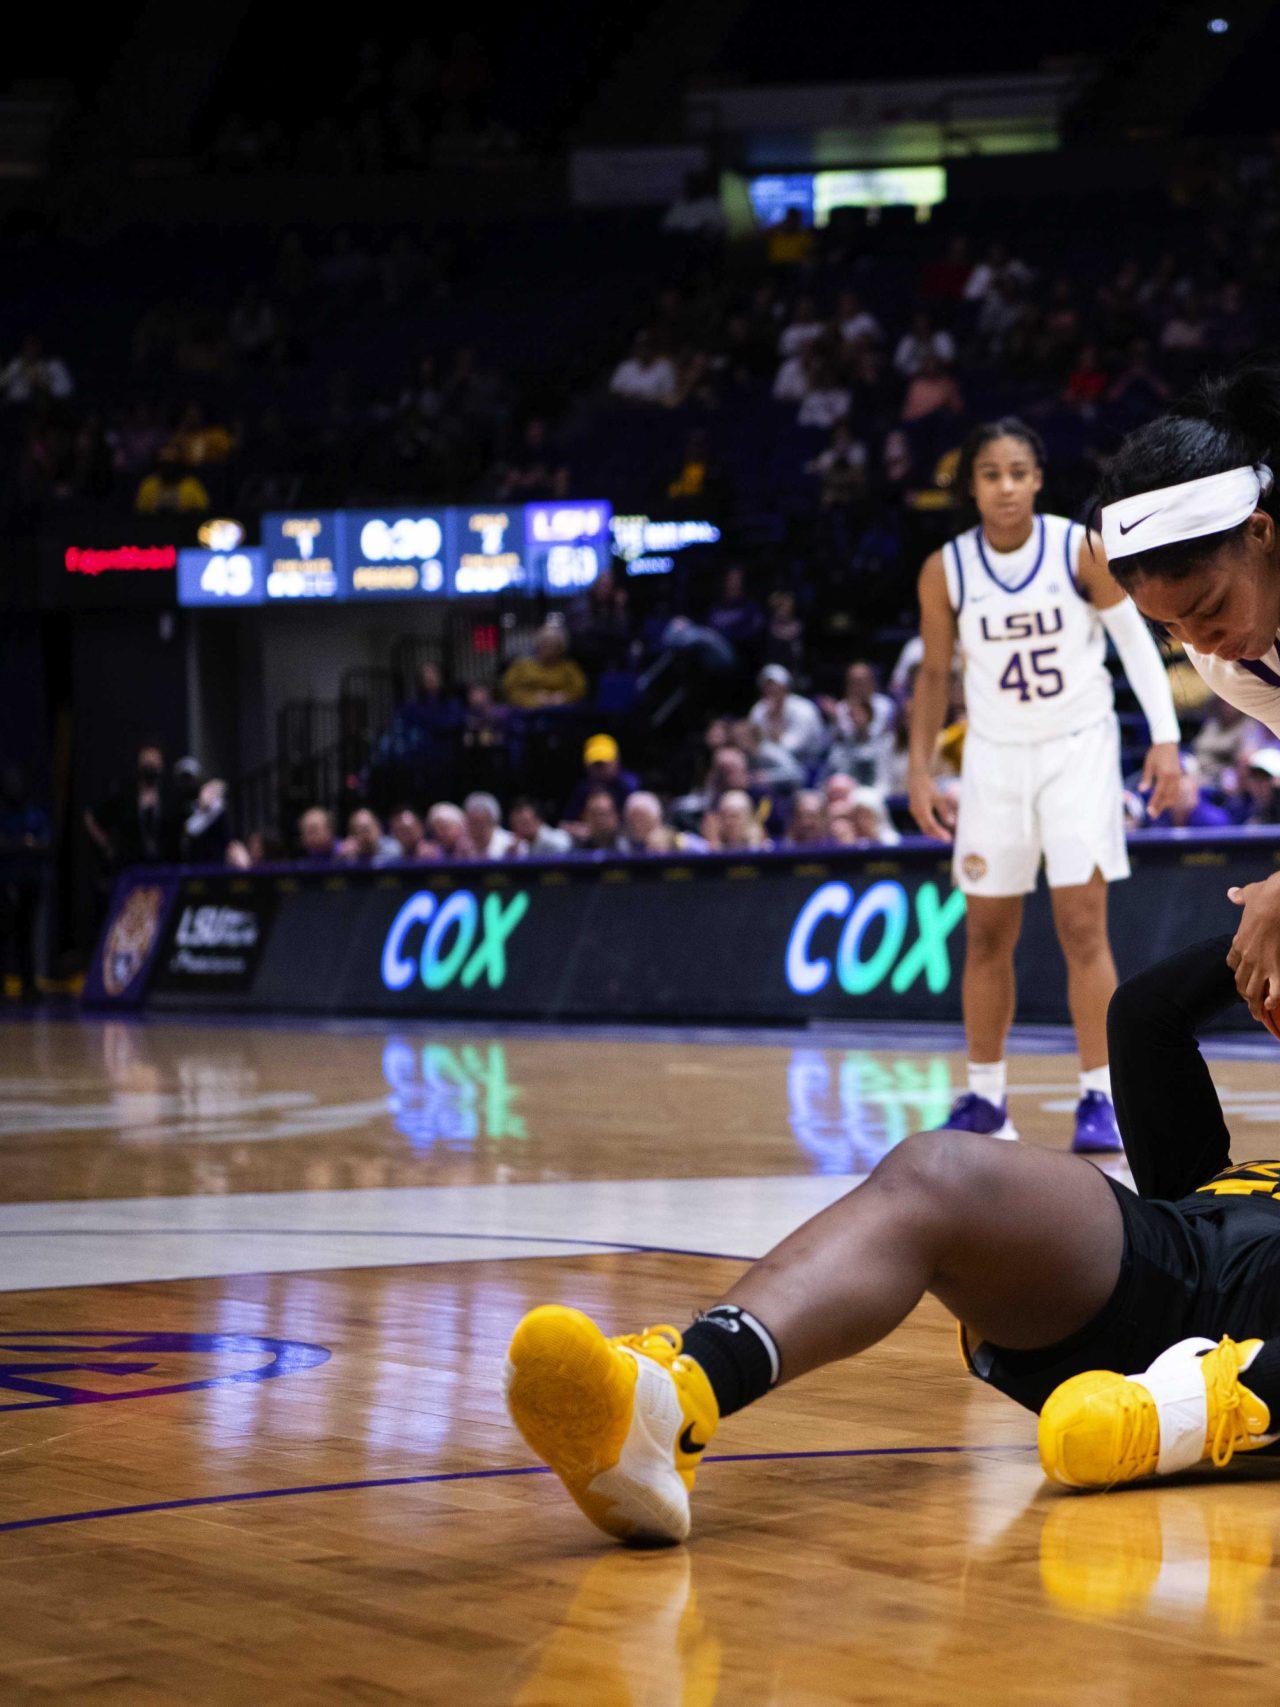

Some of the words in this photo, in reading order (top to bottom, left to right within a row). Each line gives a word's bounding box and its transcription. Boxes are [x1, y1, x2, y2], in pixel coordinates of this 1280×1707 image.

[980, 607, 1064, 641] LSU
[1000, 648, 1064, 702] 45
[381, 889, 531, 991] COX
[784, 879, 967, 996] COX
